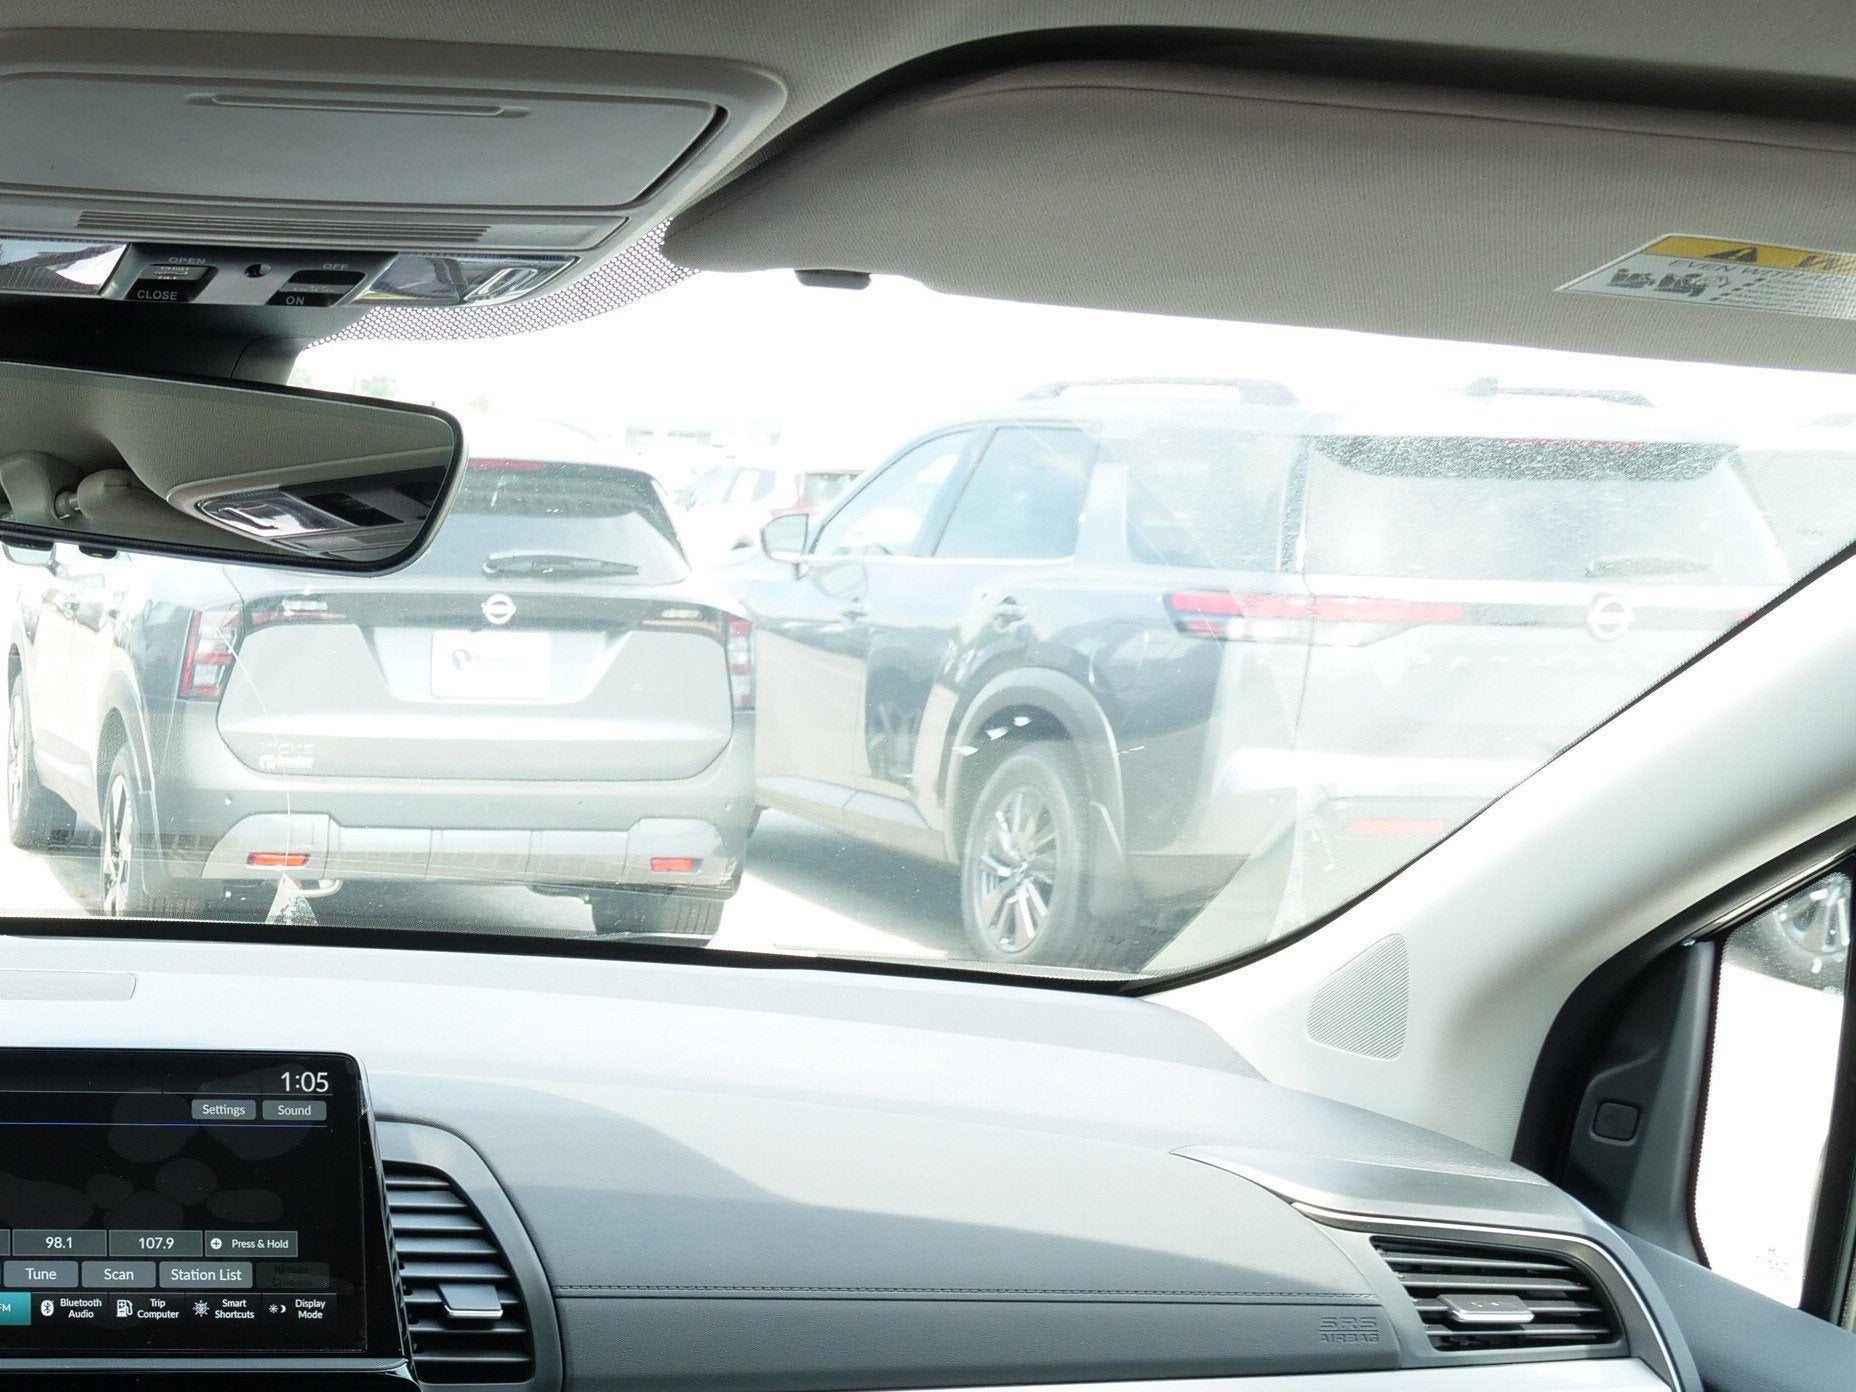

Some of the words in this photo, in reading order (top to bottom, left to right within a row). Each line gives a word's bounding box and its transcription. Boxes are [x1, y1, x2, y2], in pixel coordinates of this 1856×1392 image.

[137, 290, 177, 300] CLOSE
[286, 297, 304, 305] ON
[281, 1072, 329, 1092] 1:05
[202, 1104, 245, 1117] Settings
[278, 1106, 311, 1116] Sound
[46, 1237, 72, 1248] 98.1
[139, 1238, 174, 1249] 107.9
[232, 1240, 255, 1248] Press
[258, 1240, 265, 1248] &
[268, 1239, 288, 1248] Hold
[26, 1268, 56, 1280] Tune
[104, 1269, 134, 1280] Scan
[171, 1269, 216, 1281] Station
[220, 1269, 242, 1281] List
[61, 1299, 102, 1307] Bluetooth
[150, 1299, 165, 1308] Trip
[222, 1300, 246, 1308] Smart
[296, 1300, 325, 1309] Display
[138, 1311, 179, 1319] Computer
[1321, 1317, 1378, 1328] SRS
[1321, 1333, 1379, 1342] AIRBAG
